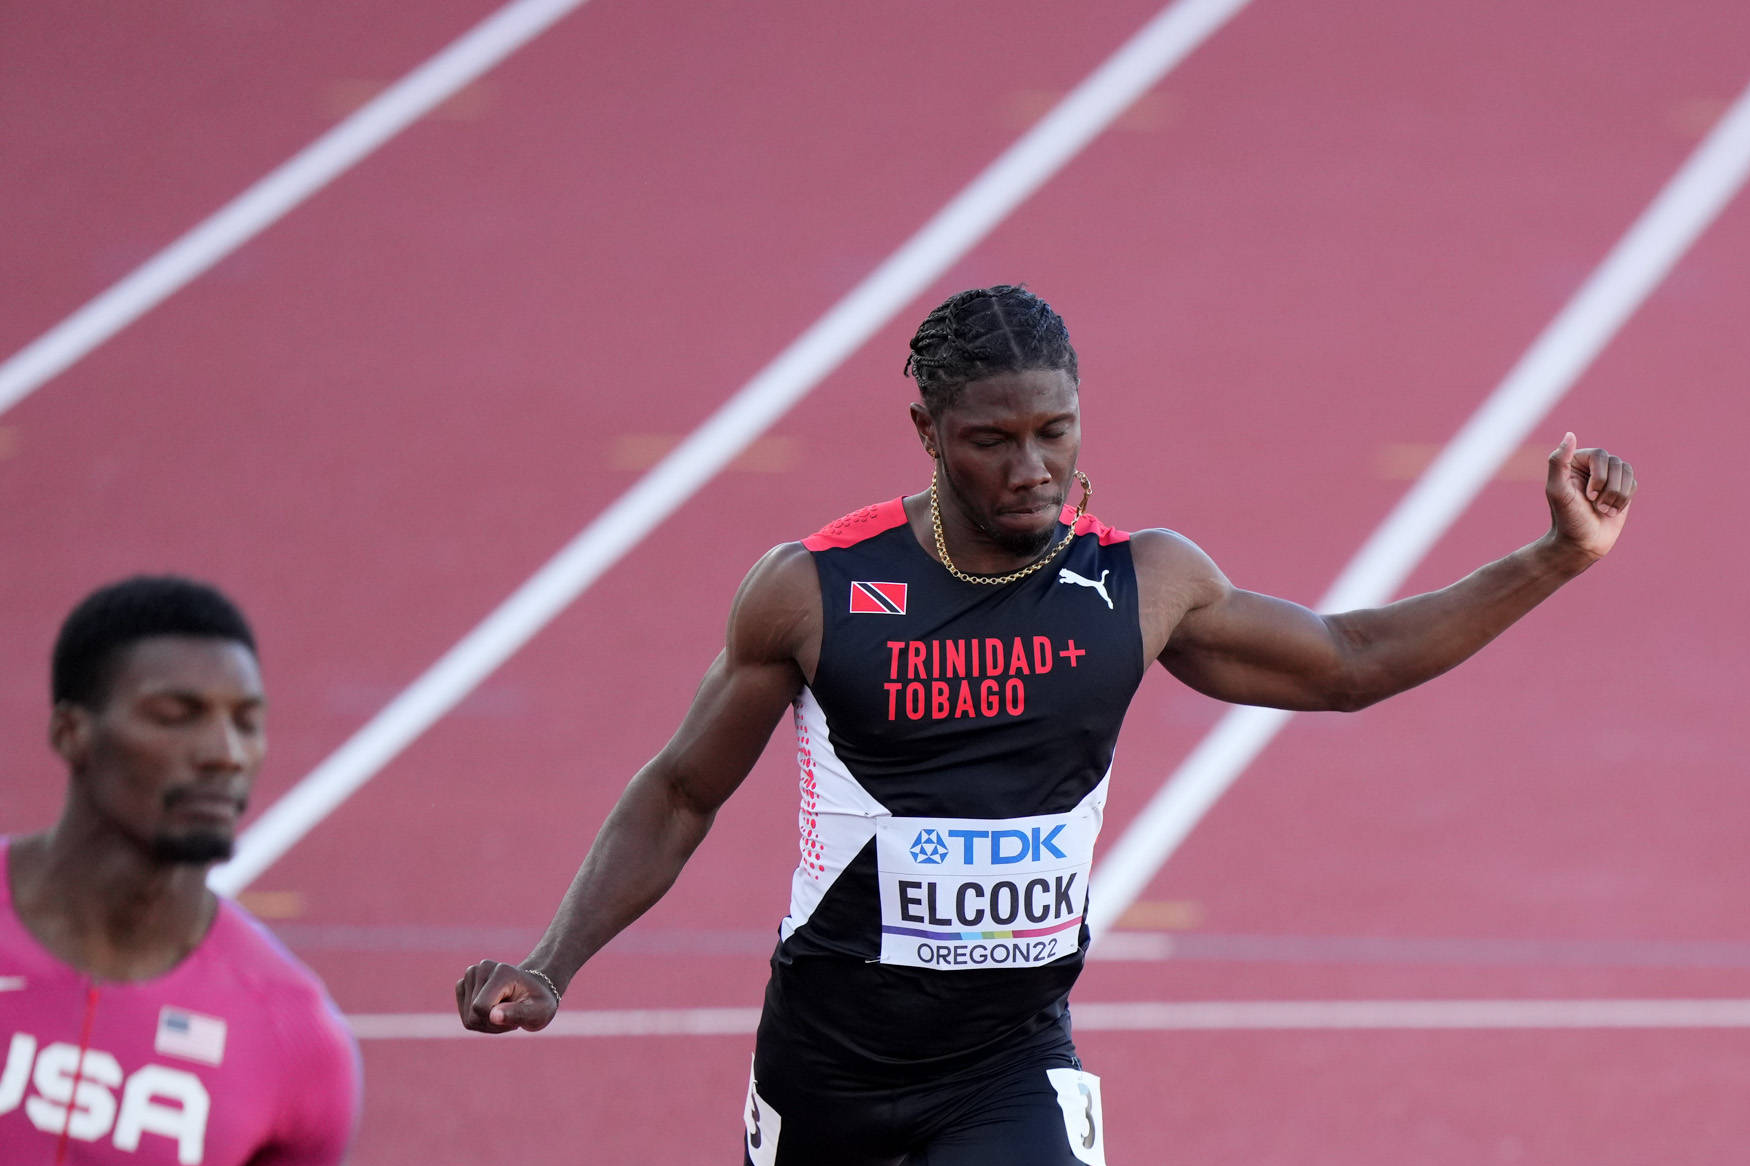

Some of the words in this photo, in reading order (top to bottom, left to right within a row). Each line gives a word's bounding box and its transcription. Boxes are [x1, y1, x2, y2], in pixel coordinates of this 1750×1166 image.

[886, 636, 1052, 679] TRINIDAD
[884, 678, 1026, 721] TOBAGO
[948, 824, 1068, 865] TDK
[898, 873, 1078, 926] ELCOCK
[917, 939, 1058, 966] OREGON22
